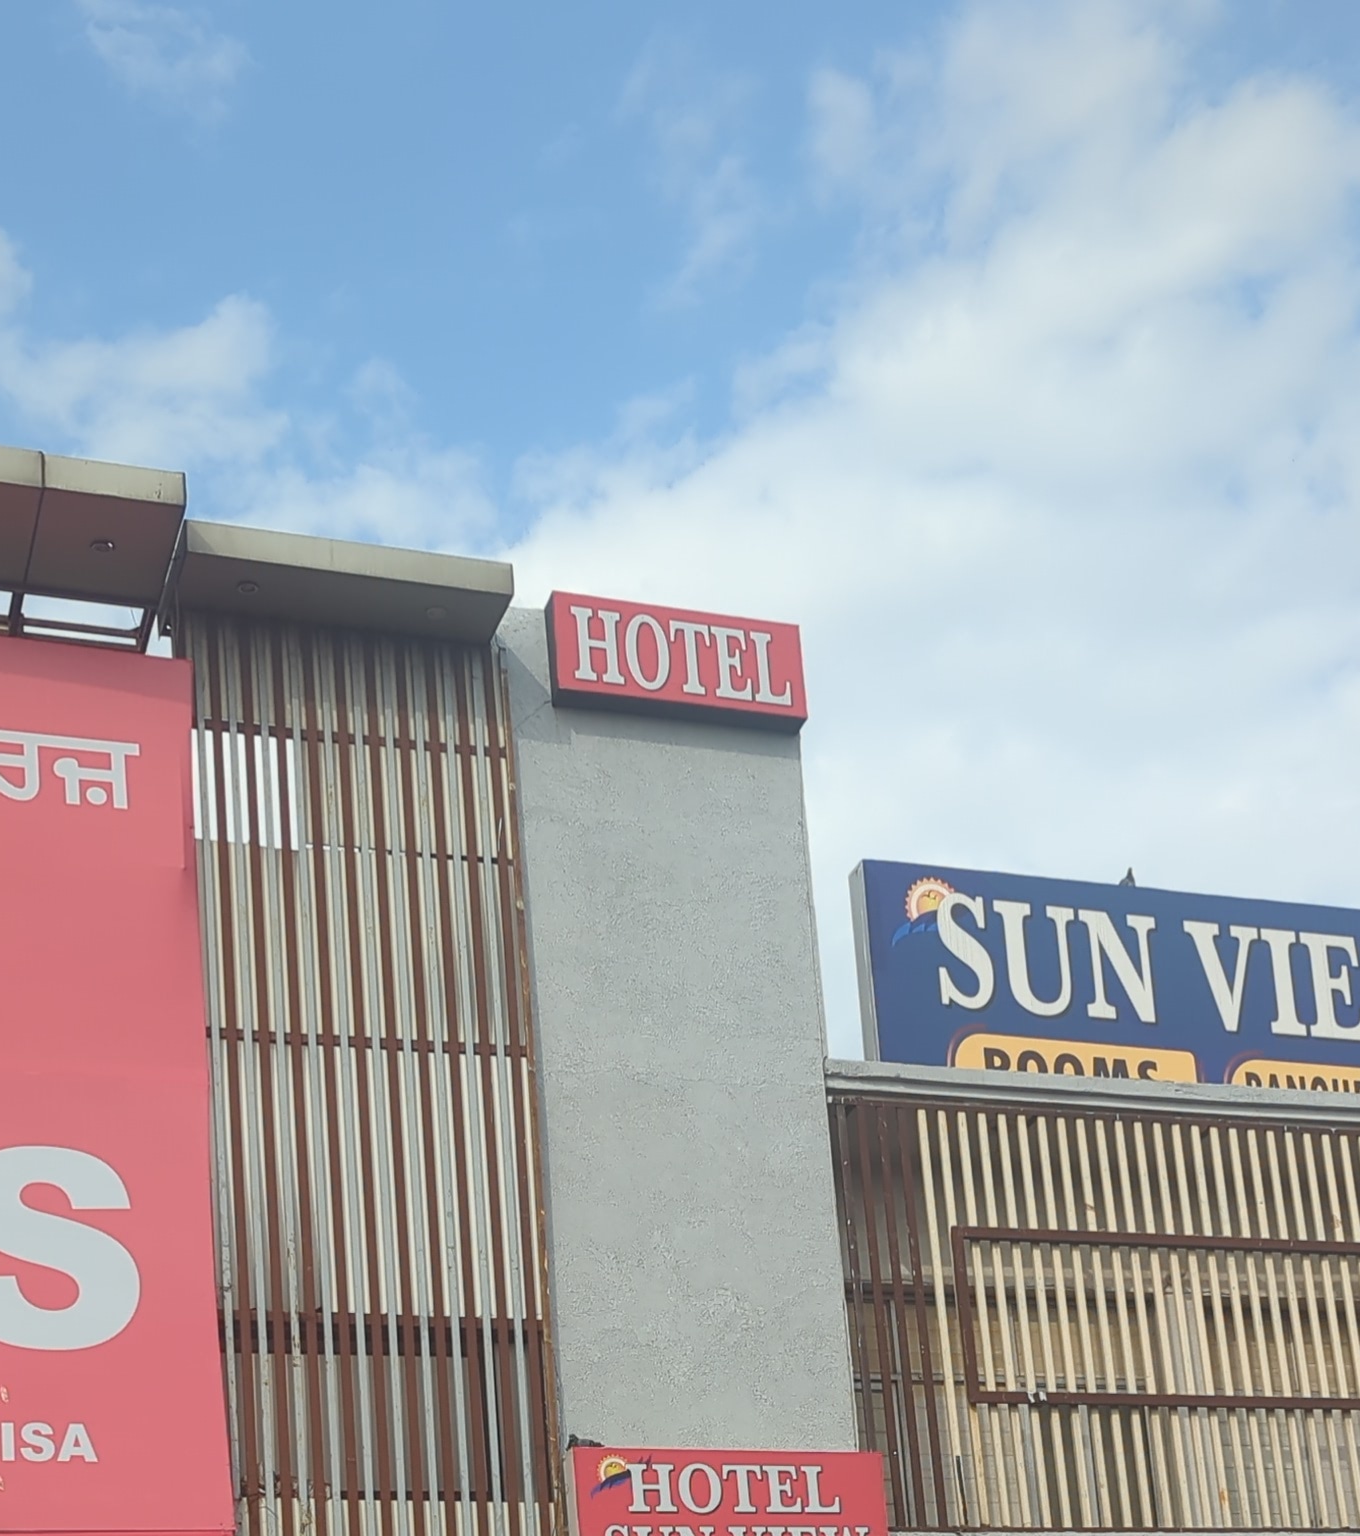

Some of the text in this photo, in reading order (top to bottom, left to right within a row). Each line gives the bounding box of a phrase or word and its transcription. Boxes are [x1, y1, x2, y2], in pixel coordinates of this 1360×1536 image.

[570, 605, 792, 706] HOTEL
[937, 890, 1158, 1024] SUN
[624, 1462, 840, 1514] HOTEL
